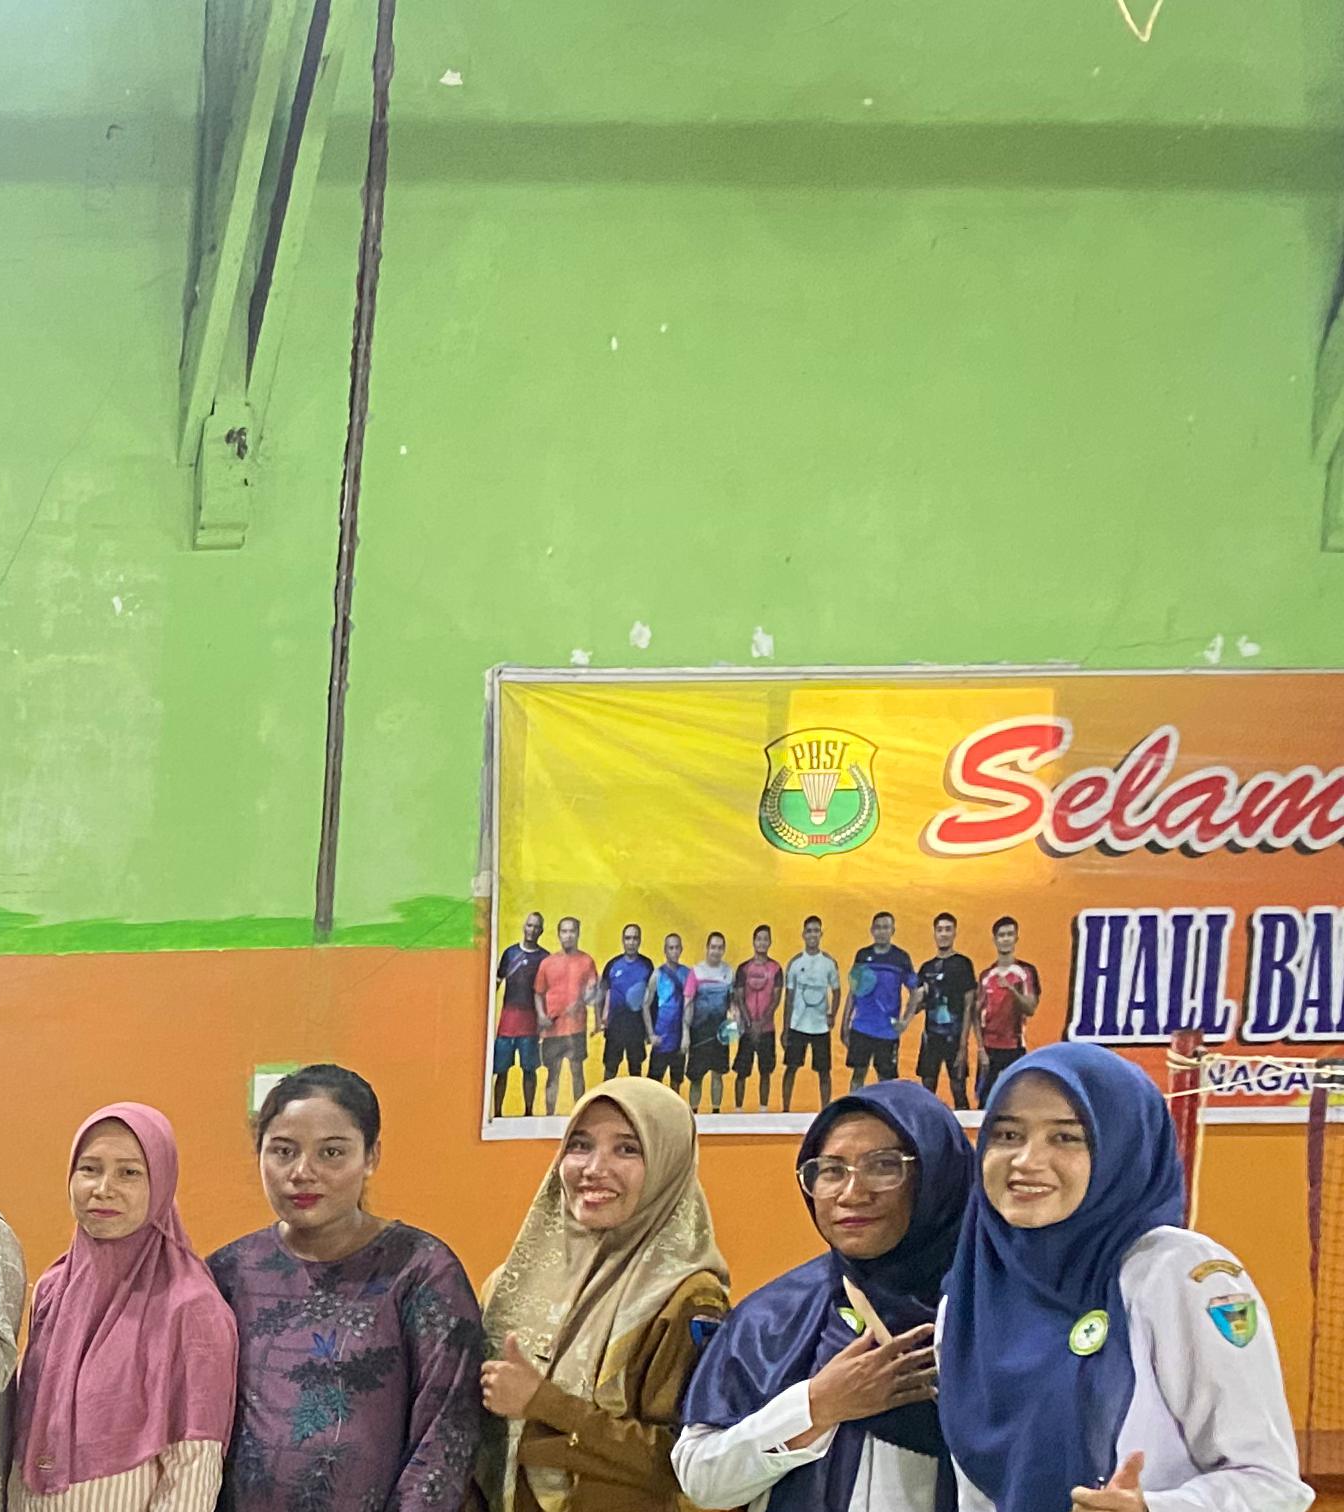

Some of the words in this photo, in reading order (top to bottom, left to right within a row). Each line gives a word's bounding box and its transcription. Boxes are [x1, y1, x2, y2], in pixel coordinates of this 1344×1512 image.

[789, 740, 850, 769] PBSI
[1074, 912, 1235, 1038] HALL
[1250, 911, 1344, 1036] BA
[1205, 1061, 1338, 1093] NAGA
